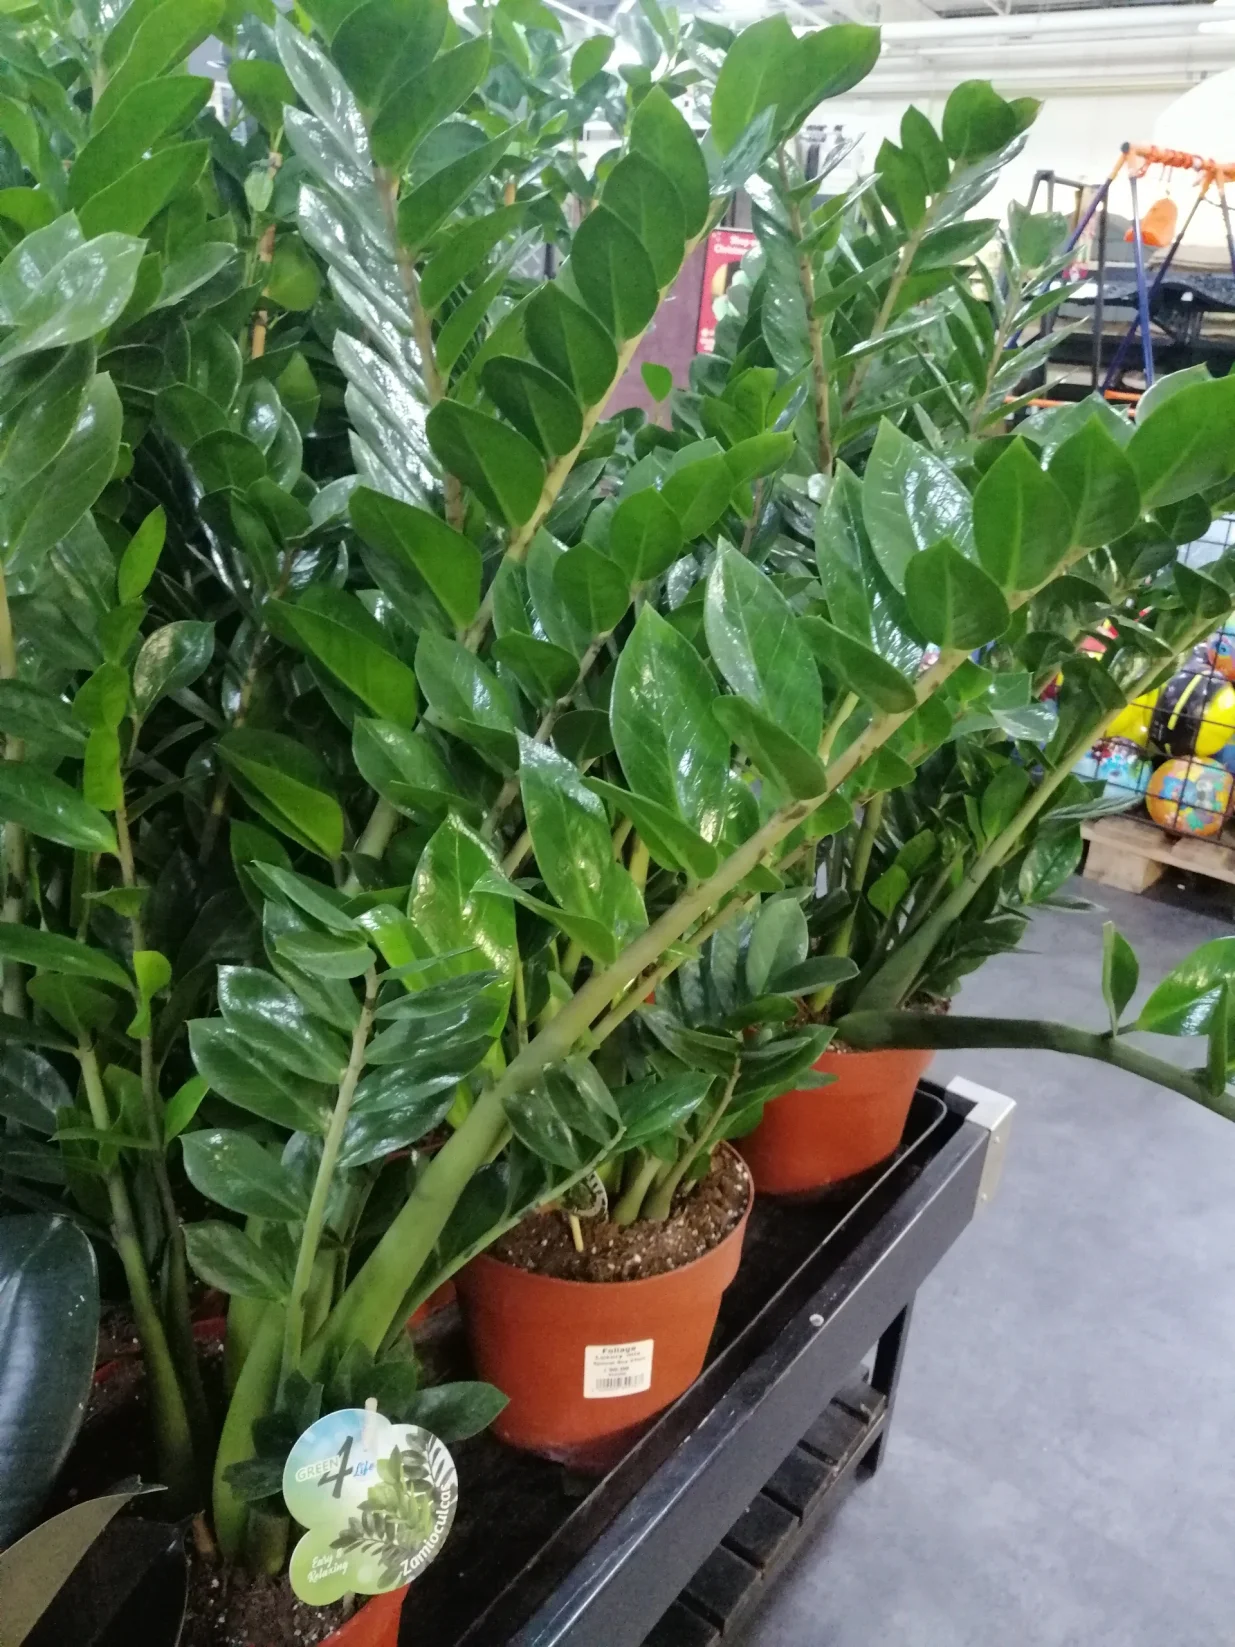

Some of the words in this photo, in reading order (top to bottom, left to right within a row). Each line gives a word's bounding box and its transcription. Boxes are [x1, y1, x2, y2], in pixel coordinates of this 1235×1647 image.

[602, 1346, 636, 1354] Foliage
[297, 1457, 340, 1481] GREEN
[317, 1435, 354, 1499] 4
[353, 1460, 375, 1477] Life
[400, 1483, 451, 1577] Zamioculcas
[307, 1561, 348, 1583] Relaxing
[311, 1554, 333, 1569] Easy
